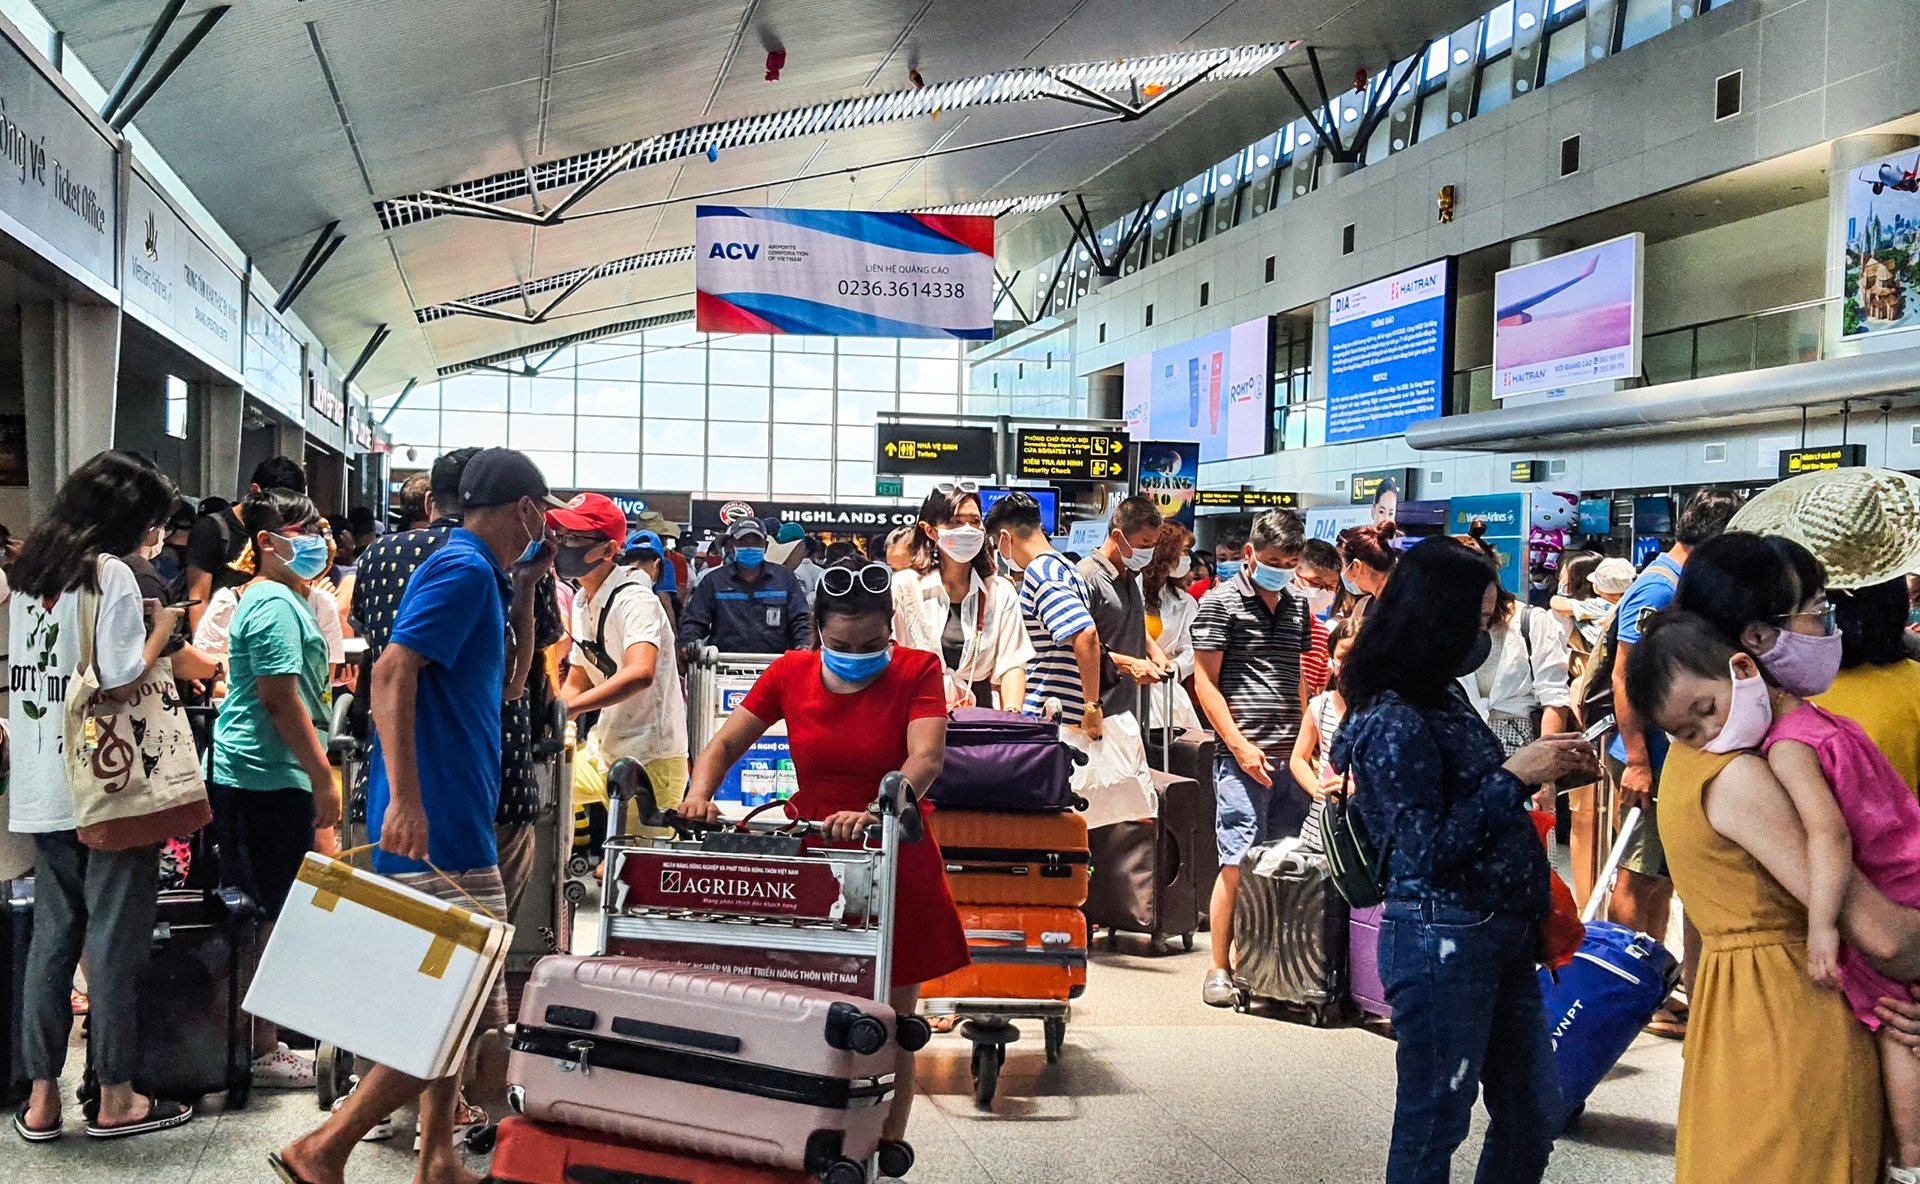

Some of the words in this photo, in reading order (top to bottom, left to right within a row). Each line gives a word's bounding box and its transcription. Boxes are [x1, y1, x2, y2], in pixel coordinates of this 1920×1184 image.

[53, 158, 81, 216] Ticket
[82, 184, 105, 234] Office
[708, 242, 760, 260] ACV
[931, 264, 950, 275] CÁO
[837, 279, 965, 299] 0236.3614338
[1335, 296, 1350, 313] DIA
[1023, 466, 1050, 475] Security
[884, 484, 900, 494] EXIT
[781, 510, 887, 524] HIGHLANDS
[891, 514, 919, 525] CO
[1073, 529, 1086, 545] DIA
[1313, 519, 1336, 540] DIA
[750, 762, 769, 770] TOA
[682, 877, 797, 900] AGRIBANK
[722, 964, 732, 973] VÀ
[732, 965, 752, 976] PHÁT
[753, 965, 775, 977] TRIỂN
[776, 967, 799, 979] NÔNG
[800, 969, 821, 981] THÔN
[822, 971, 839, 984] VIỆT
[839, 974, 858, 984] NAM
[1552, 999, 1583, 1037] VNPT
